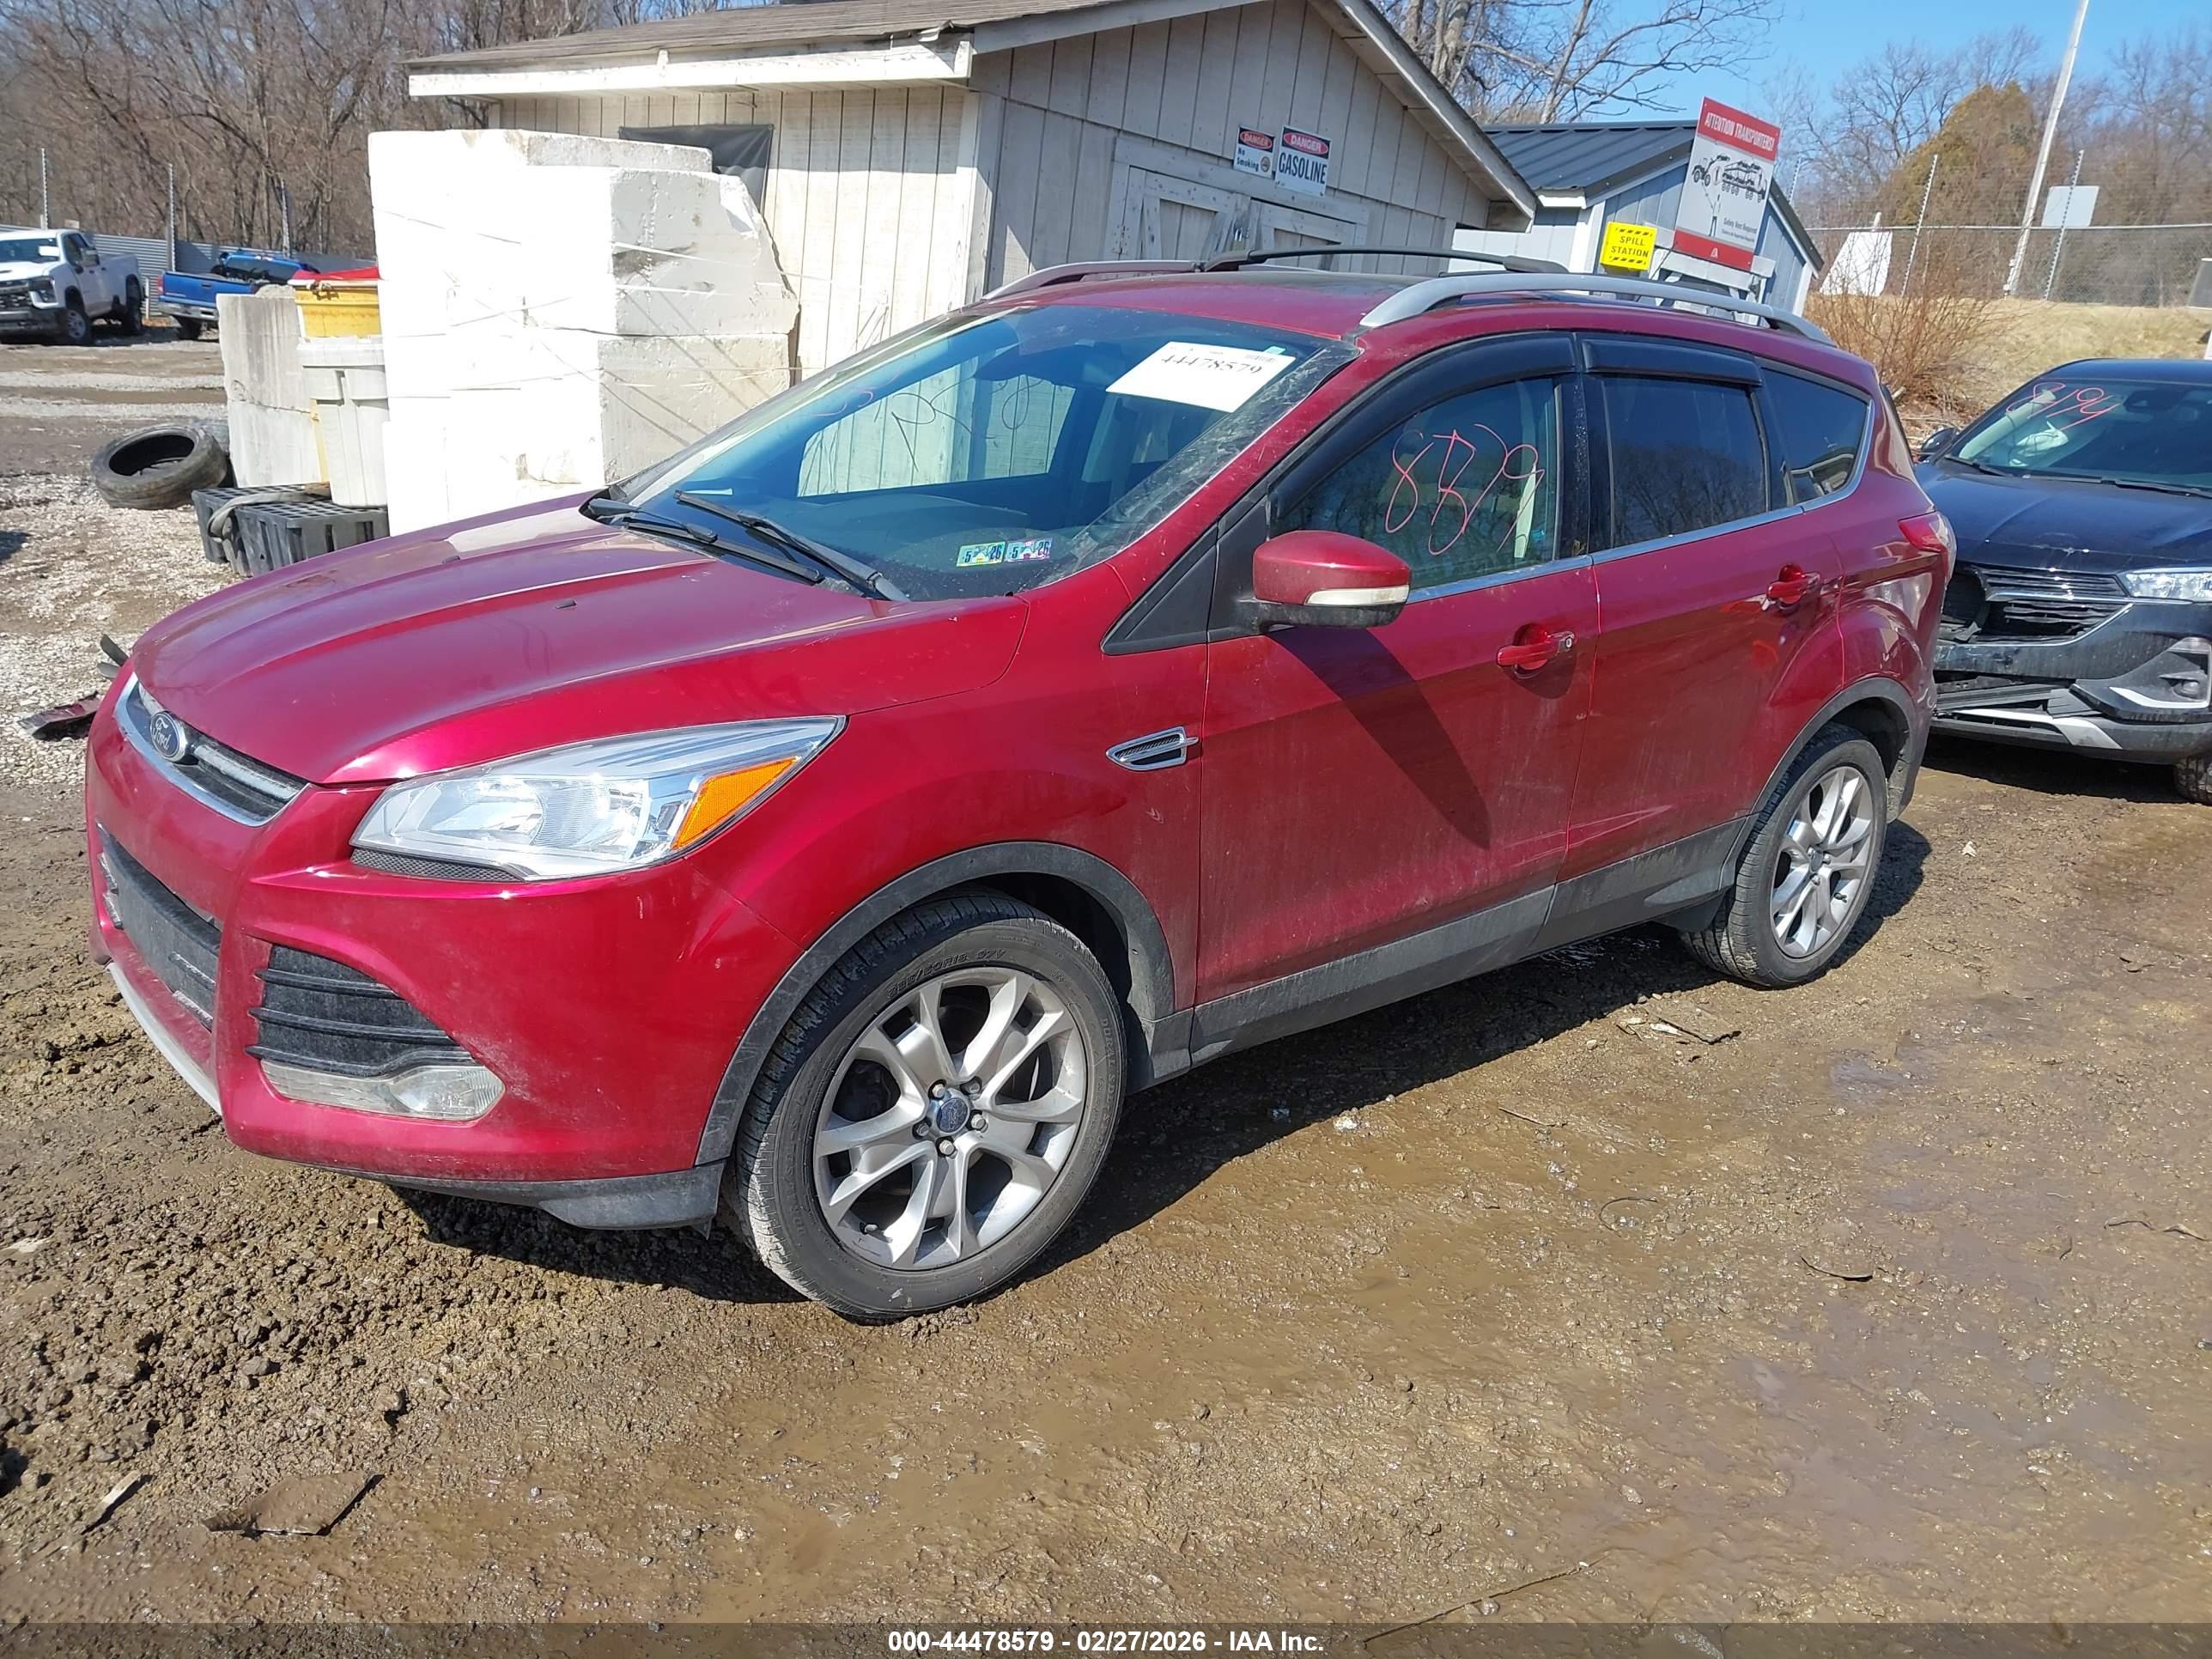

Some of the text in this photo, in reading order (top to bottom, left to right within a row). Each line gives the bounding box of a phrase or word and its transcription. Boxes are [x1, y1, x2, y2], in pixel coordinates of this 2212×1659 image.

[1705, 112, 1735, 136] ATTENTION
[1244, 133, 1268, 147] DANGER
[1291, 135, 1321, 153] DANGER
[1237, 156, 1260, 172] Smoking
[1278, 152, 1328, 184] GASOLINE
[1619, 235, 1645, 246] SPILL
[1610, 246, 1649, 258] STATION
[964, 545, 1002, 563] 5 26
[1012, 541, 1049, 559] 5 26
[152, 716, 172, 750] Ford
